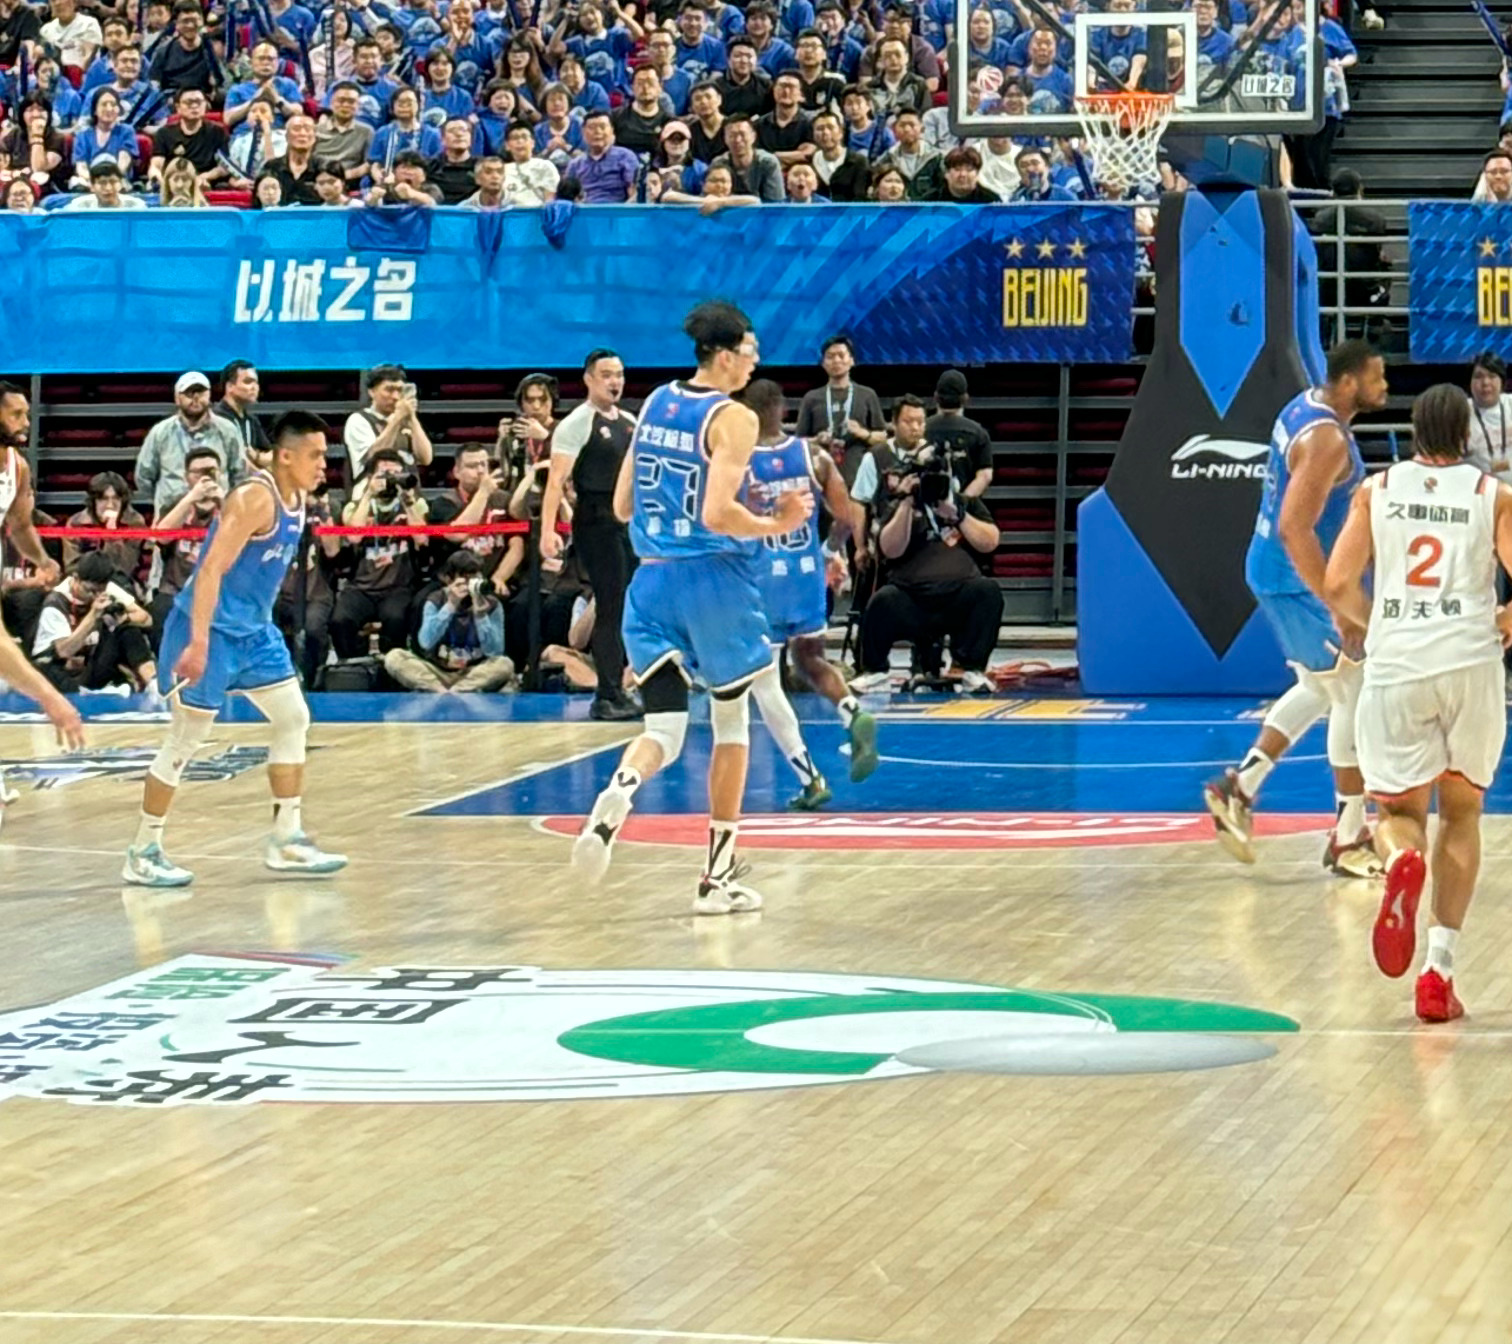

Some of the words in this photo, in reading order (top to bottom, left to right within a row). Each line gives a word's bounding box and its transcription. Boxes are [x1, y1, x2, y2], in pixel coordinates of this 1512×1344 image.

[233, 258, 416, 324] 以城之名
[1003, 267, 1087, 327] BEIJING
[1405, 534, 1443, 588] 2
